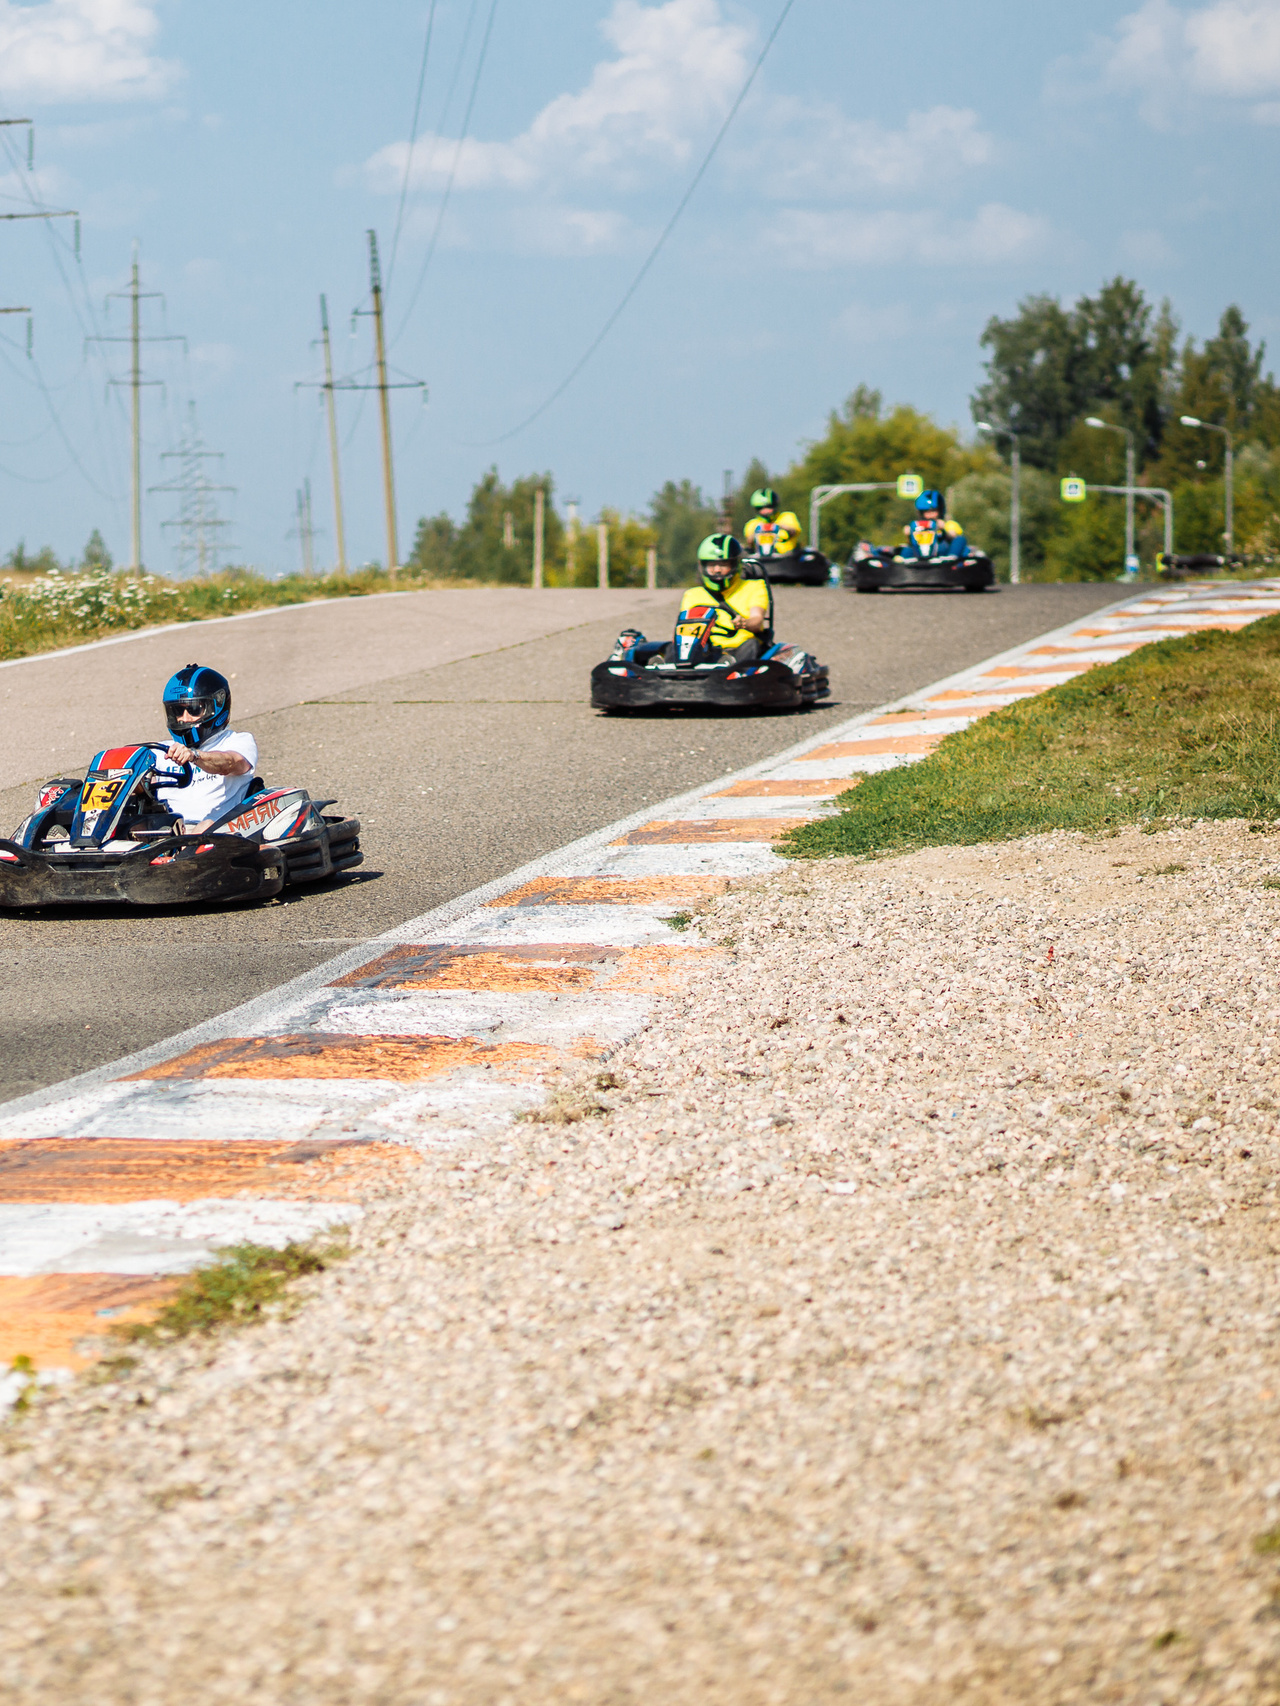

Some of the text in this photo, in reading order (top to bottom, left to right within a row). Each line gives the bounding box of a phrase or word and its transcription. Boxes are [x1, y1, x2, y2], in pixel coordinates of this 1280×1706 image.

[679, 625, 701, 638] 14
[81, 781, 123, 805] 19
[227, 799, 282, 833] МАЯК
